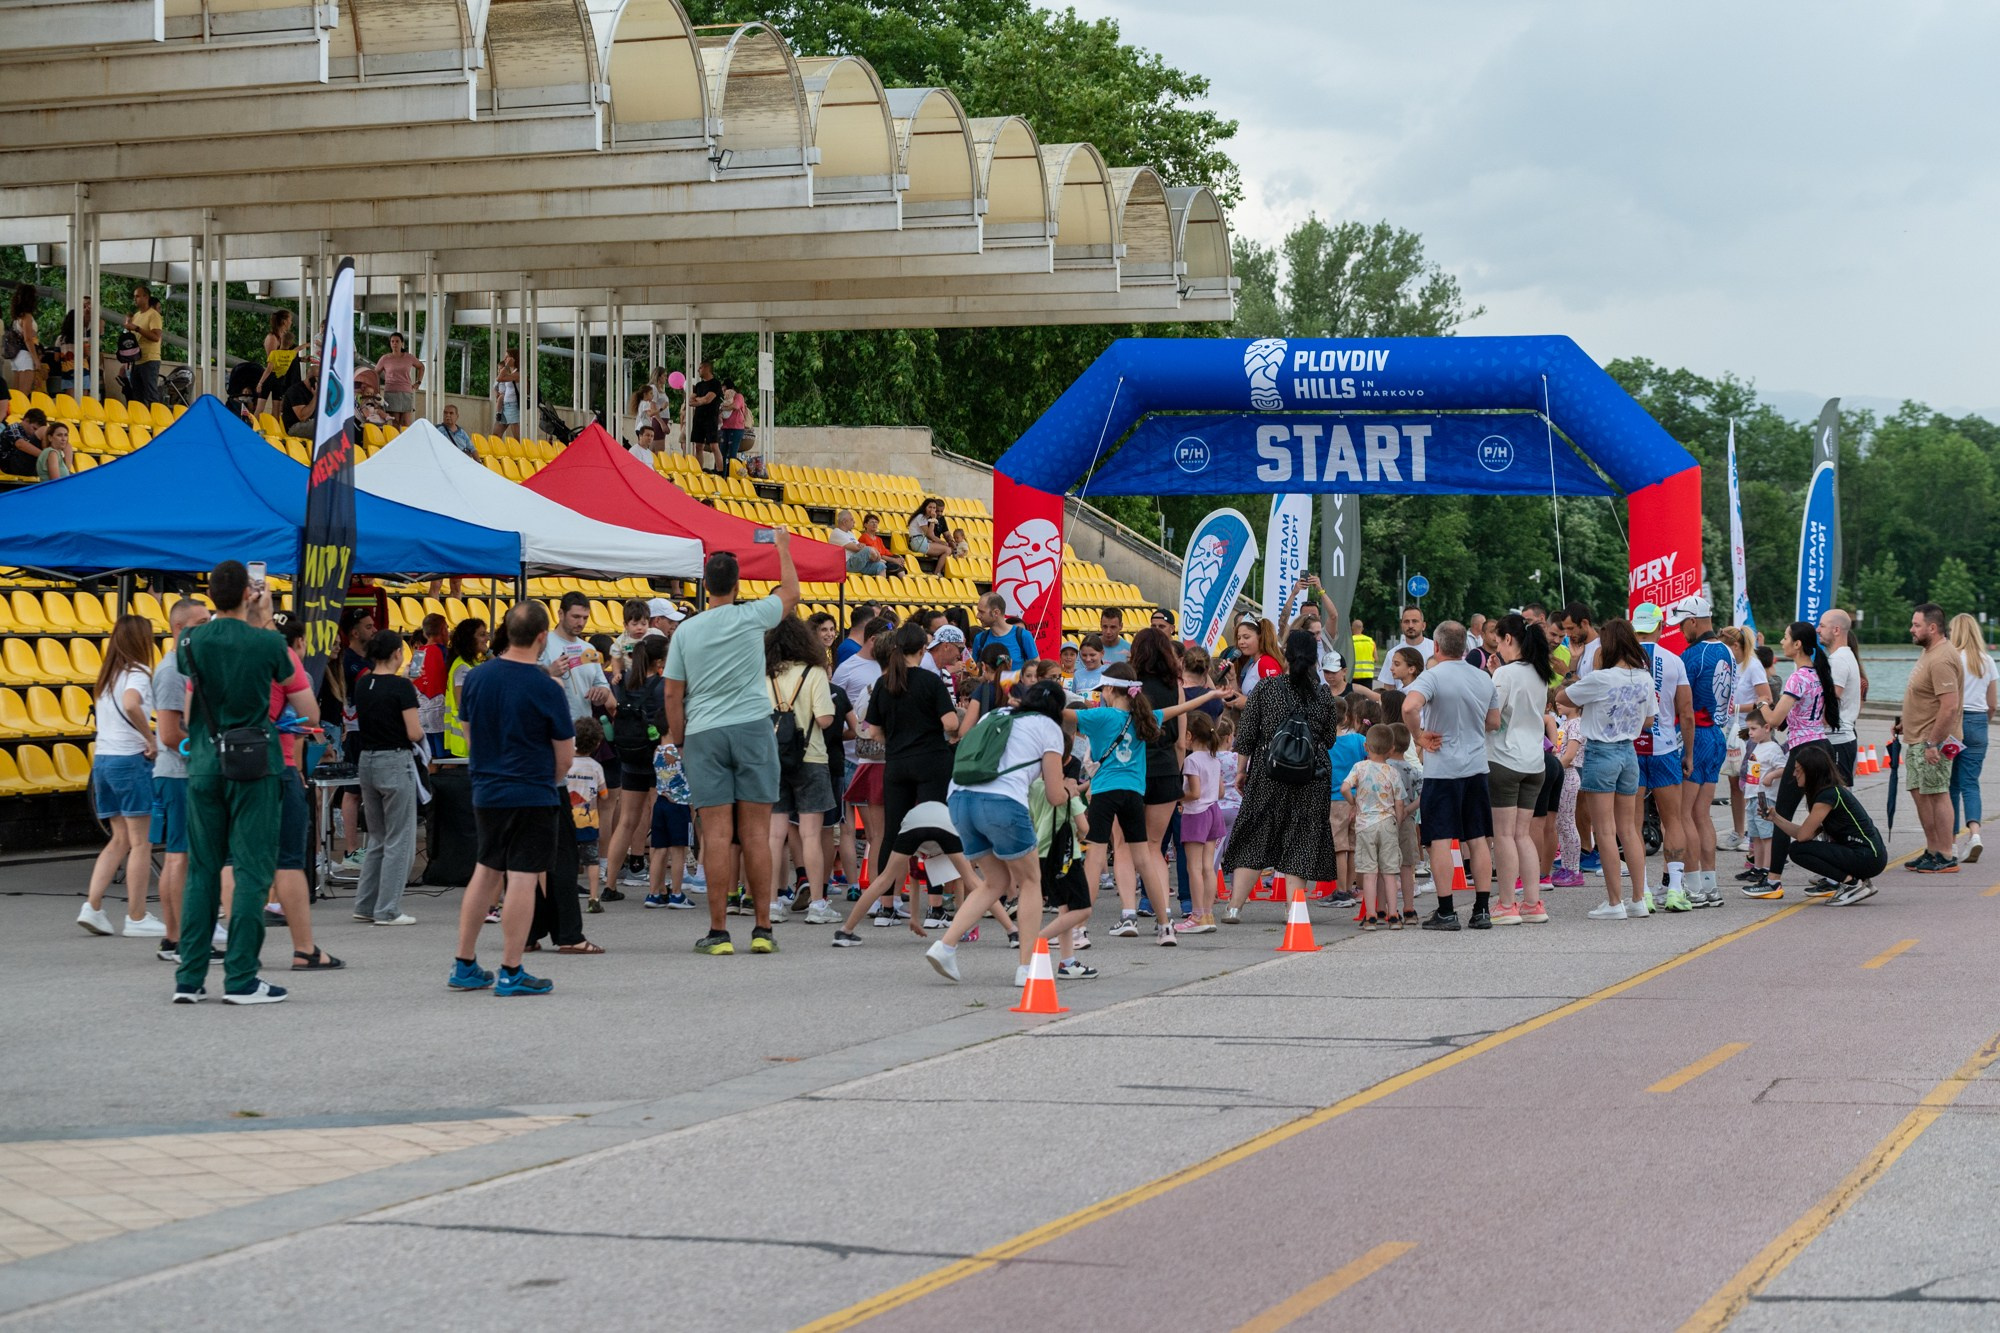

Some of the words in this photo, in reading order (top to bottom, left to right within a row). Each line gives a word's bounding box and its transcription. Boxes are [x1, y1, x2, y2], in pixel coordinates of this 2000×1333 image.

[1293, 350, 1390, 372] PLOVDIV
[1294, 377, 1356, 399] HILLS
[1361, 380, 1374, 388] IN
[1362, 389, 1425, 397] MARKOVO
[1180, 447, 1204, 460] P/H
[1256, 424, 1432, 482] START
[1484, 446, 1508, 459] P/H
[1279, 513, 1289, 581] МЕТАЛИ
[1290, 514, 1299, 570] СПОРТ
[1808, 520, 1817, 592] МЕТАЛИ
[1629, 551, 1678, 593] VERY
[1643, 568, 1696, 605] STEP
[1206, 619, 1220, 647] STEP
[1218, 573, 1240, 622] MATTERS
[1655, 656, 1663, 692] MATTERS
